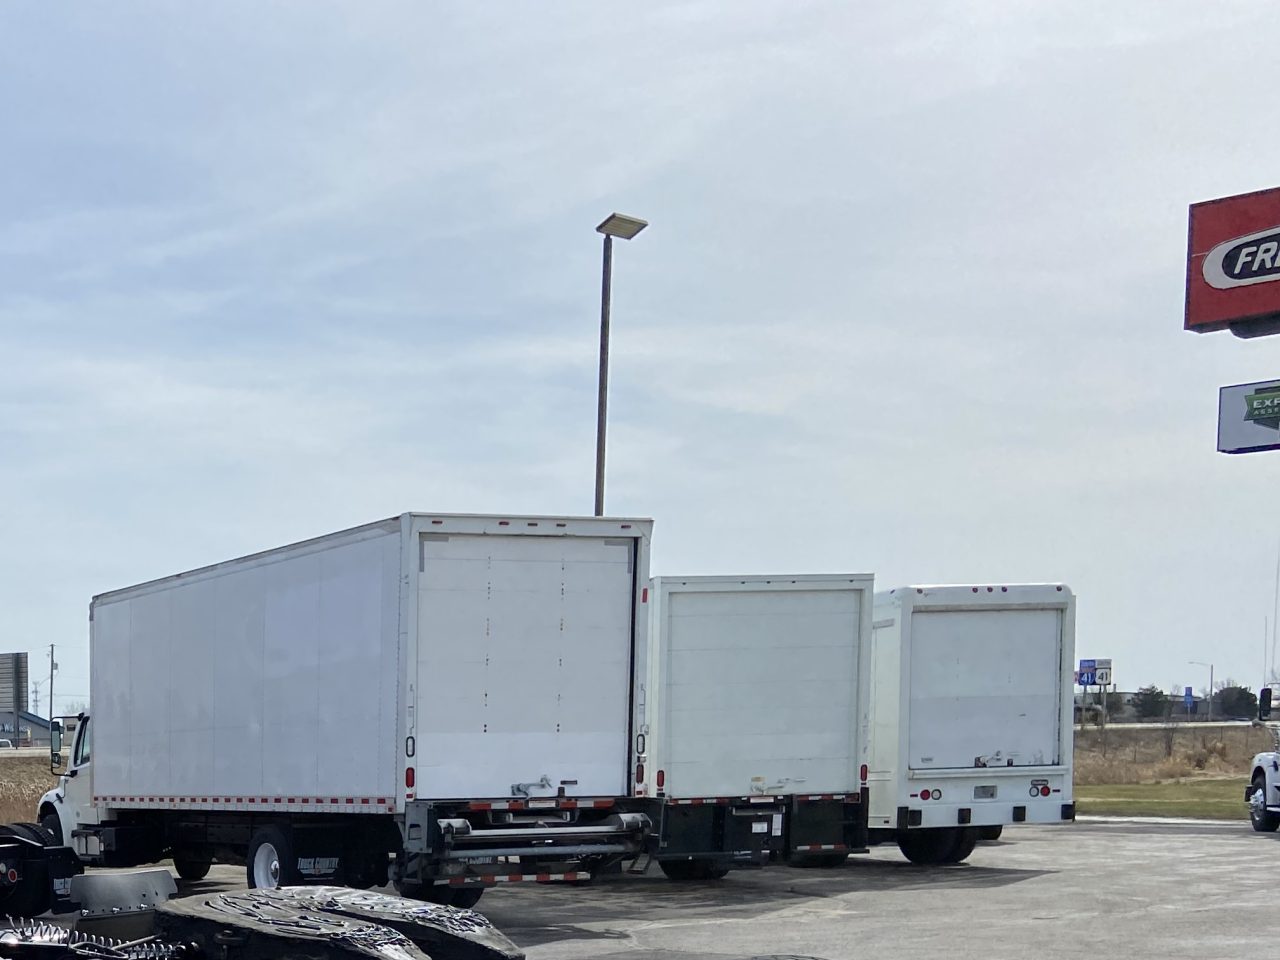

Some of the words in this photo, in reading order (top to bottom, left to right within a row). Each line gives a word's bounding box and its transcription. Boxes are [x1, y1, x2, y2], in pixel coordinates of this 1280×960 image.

[1233, 241, 1280, 275] FR
[1081, 672, 1093, 683] 41
[1098, 671, 1108, 682] 41
